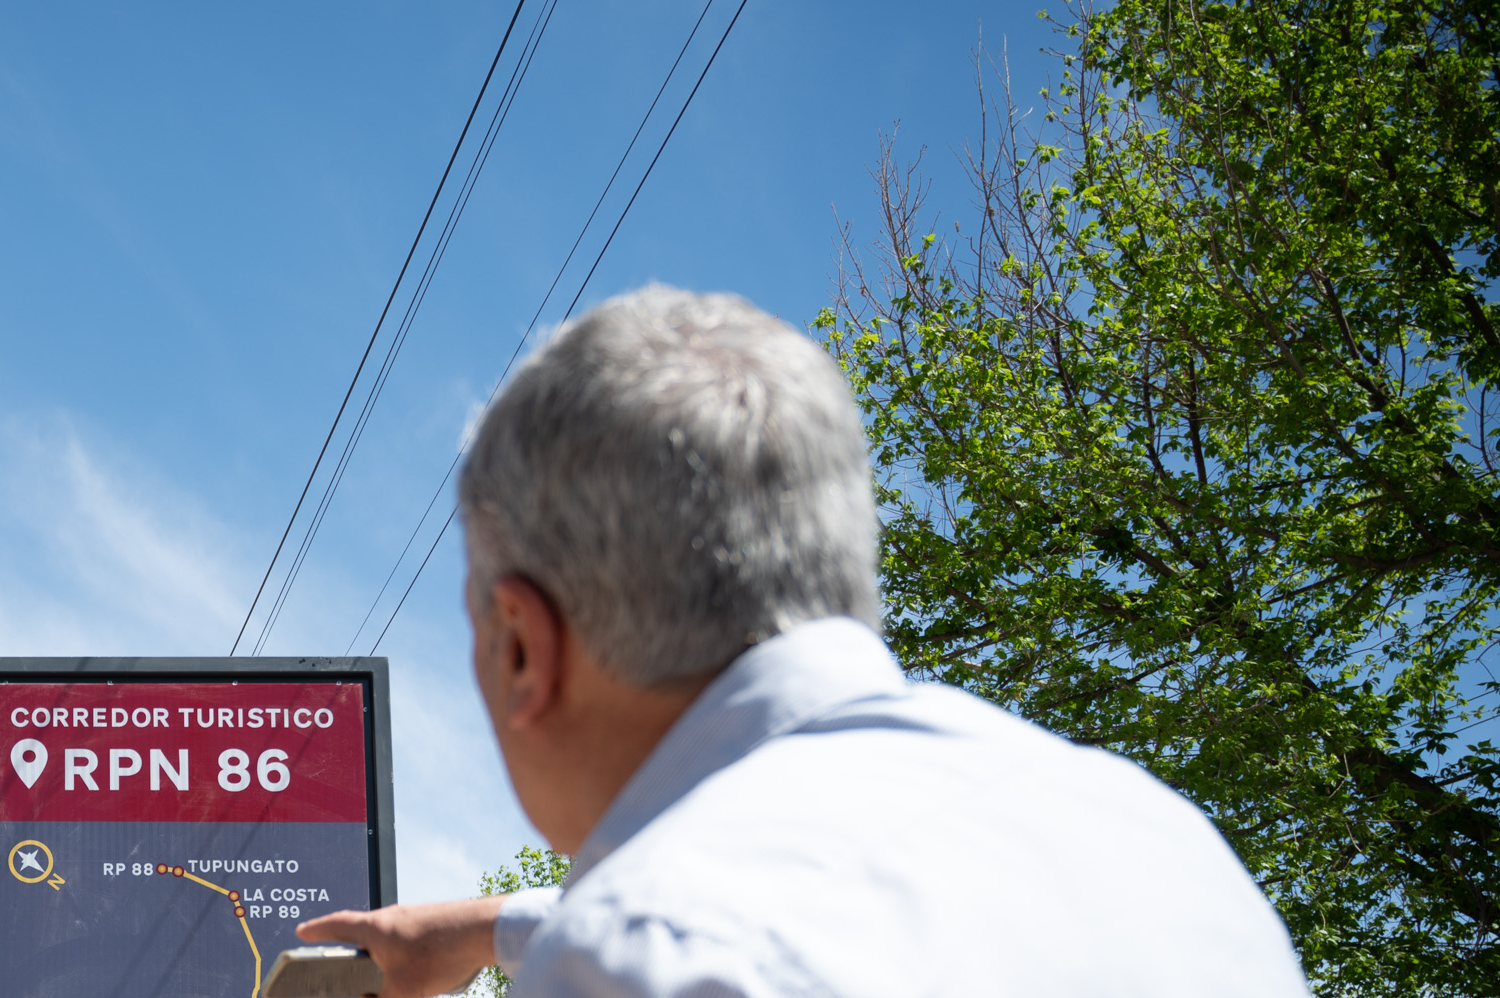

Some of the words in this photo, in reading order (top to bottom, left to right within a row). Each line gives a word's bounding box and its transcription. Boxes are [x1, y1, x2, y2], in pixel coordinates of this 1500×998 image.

[10, 707, 170, 728] CORREDOR
[178, 707, 334, 728] TURISTICO
[64, 748, 190, 791] RPN
[217, 747, 291, 792] 86
[103, 863, 126, 876] RP
[131, 862, 154, 876] 88
[188, 859, 299, 874] TUPUNGATO
[243, 889, 264, 902] LA
[270, 888, 330, 902] COSTA
[249, 905, 273, 919] RP
[277, 905, 300, 919] 89
